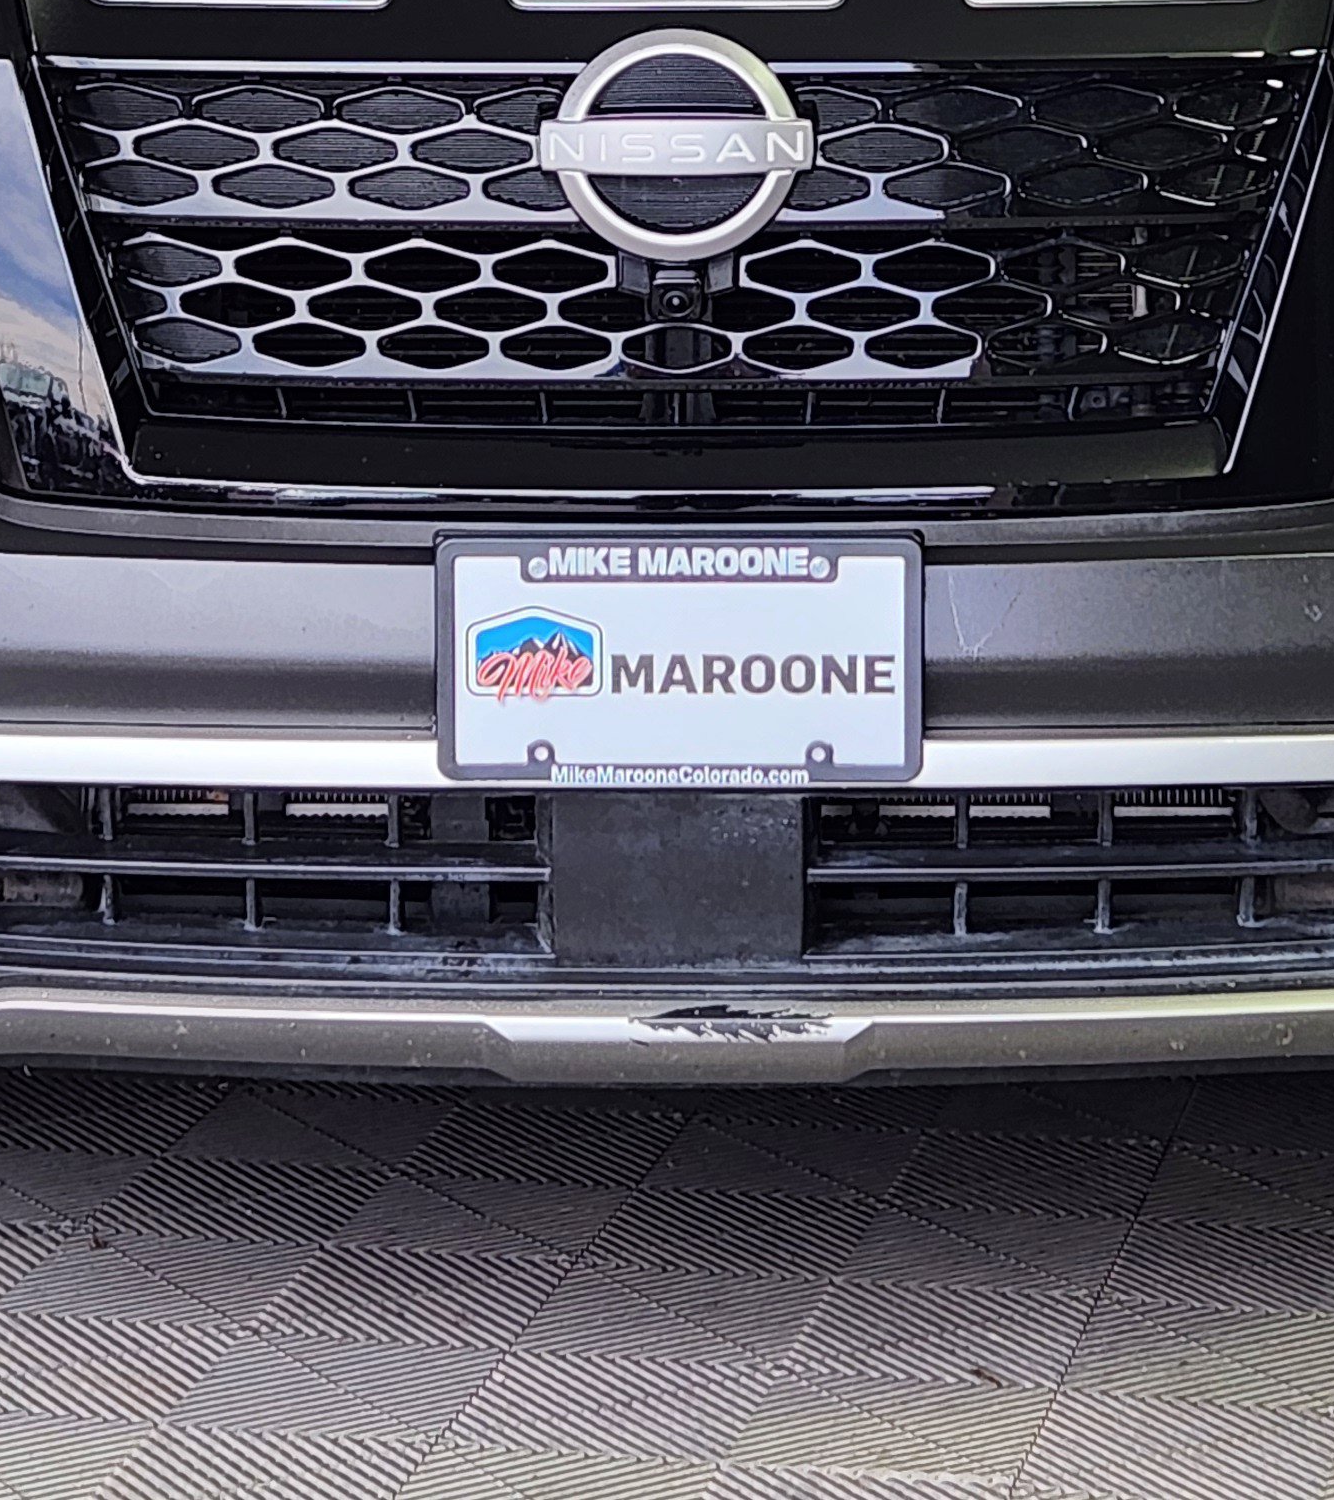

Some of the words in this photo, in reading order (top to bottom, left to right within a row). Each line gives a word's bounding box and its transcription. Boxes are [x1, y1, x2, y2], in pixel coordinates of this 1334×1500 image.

[548, 130, 804, 162] NISSAN
[548, 546, 631, 577] MIKE
[637, 545, 809, 577] MAROONE
[477, 646, 593, 703] Mike
[611, 653, 897, 695] MAROONE
[551, 764, 810, 785] MikeMarooneColorado.com
